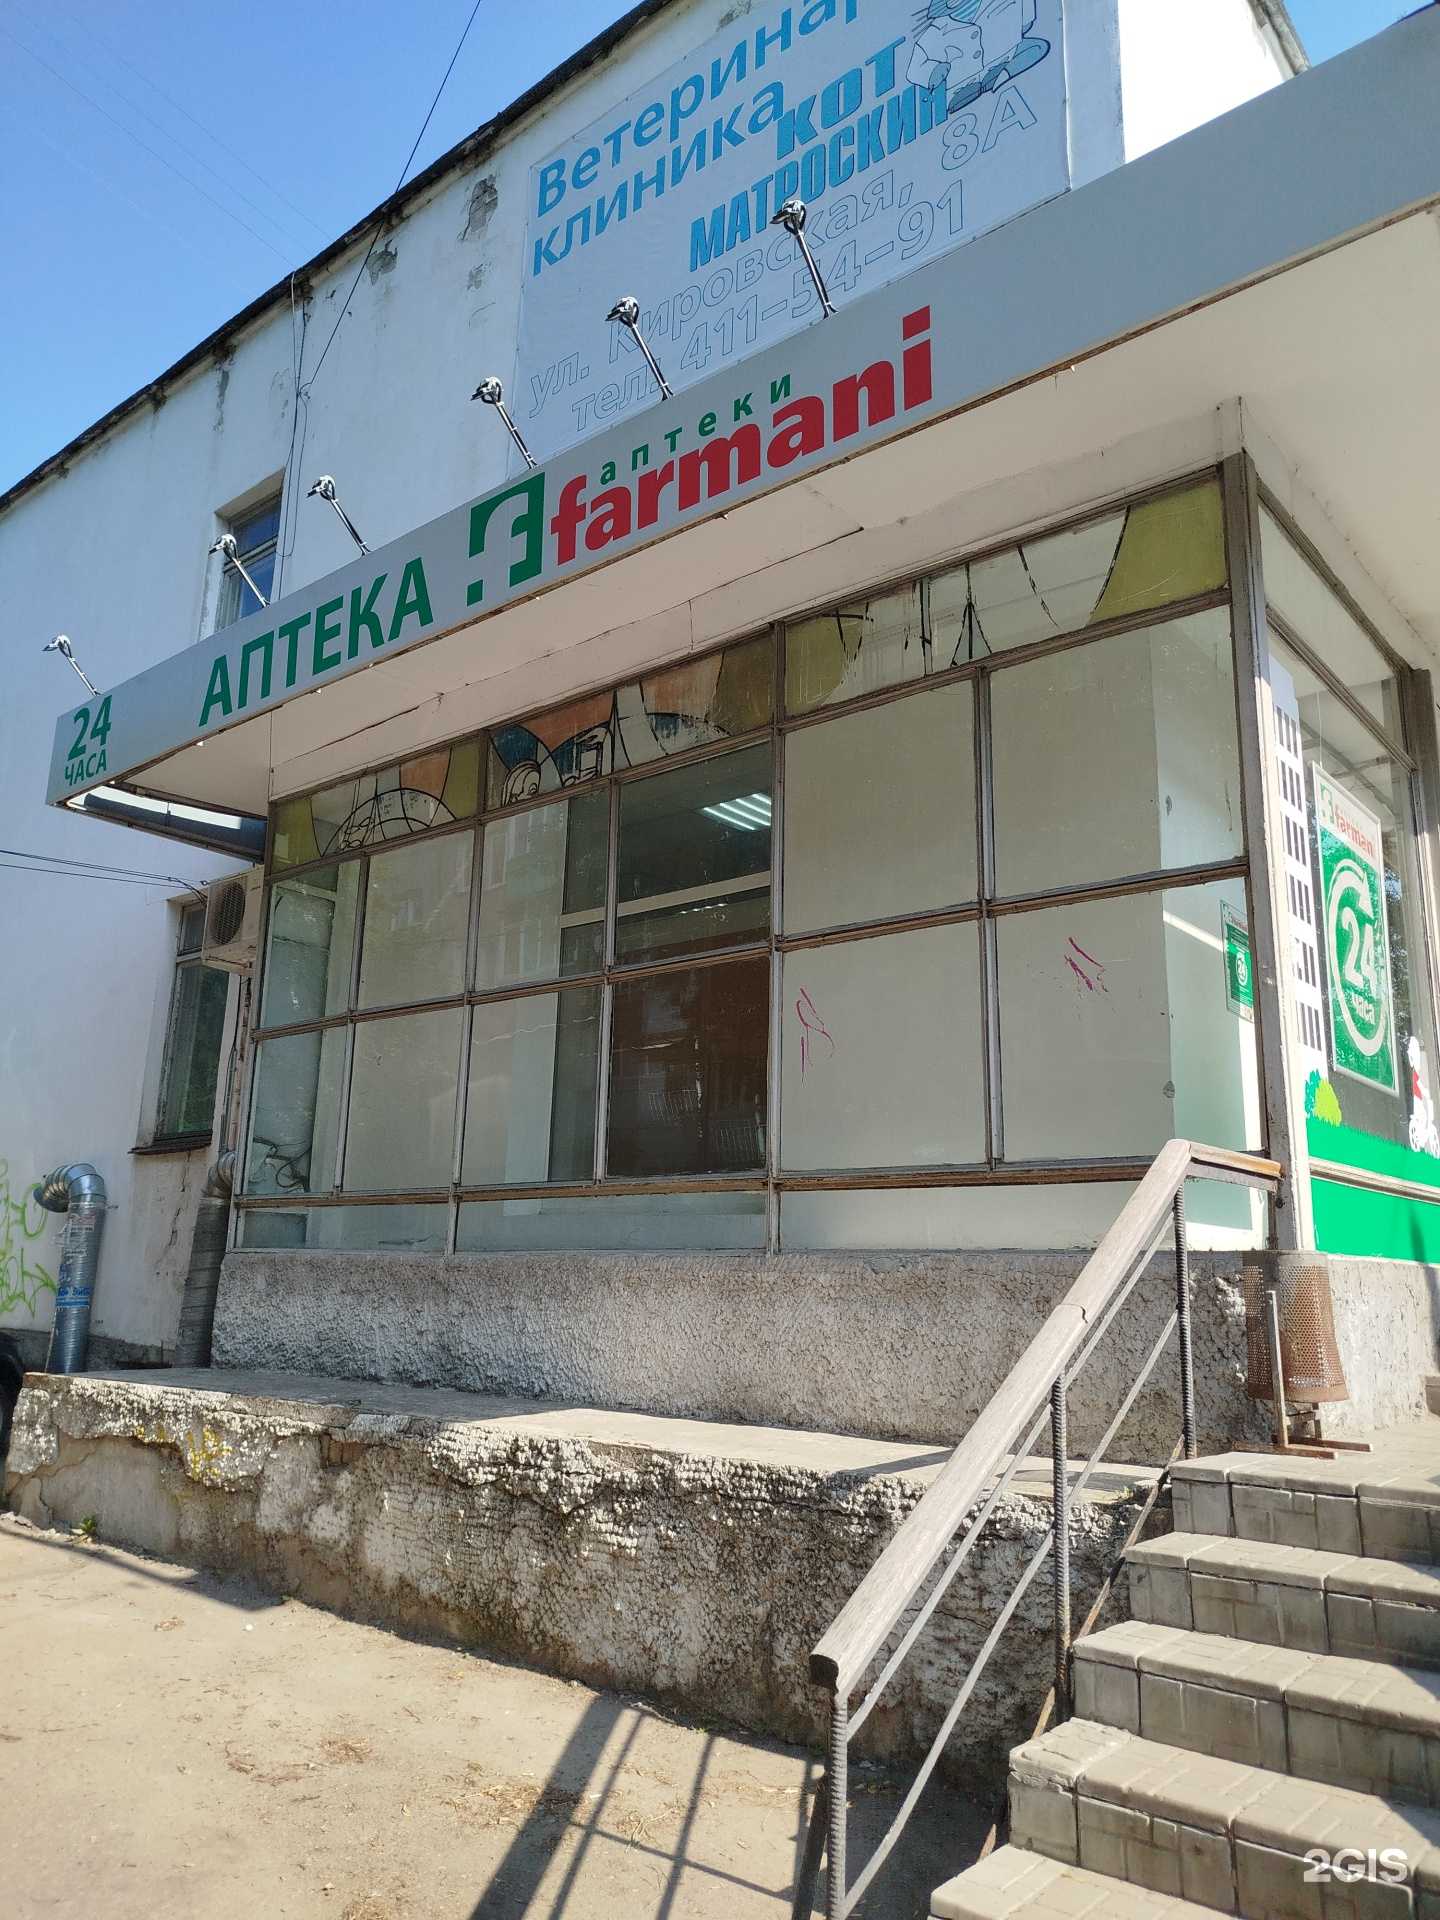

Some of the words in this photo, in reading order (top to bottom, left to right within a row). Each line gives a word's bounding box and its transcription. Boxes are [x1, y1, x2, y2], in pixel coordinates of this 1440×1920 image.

[533, 80, 785, 277] клиника
[689, 79, 949, 273] МАТРОСКИН
[529, 351, 590, 418] ул.
[551, 305, 932, 566] farmani
[600, 374, 791, 486] аптеки
[199, 556, 433, 727] АПТЕКА
[64, 749, 108, 787] ЧАСА
[67, 695, 113, 762] 24
[1341, 906, 1377, 1001] 24
